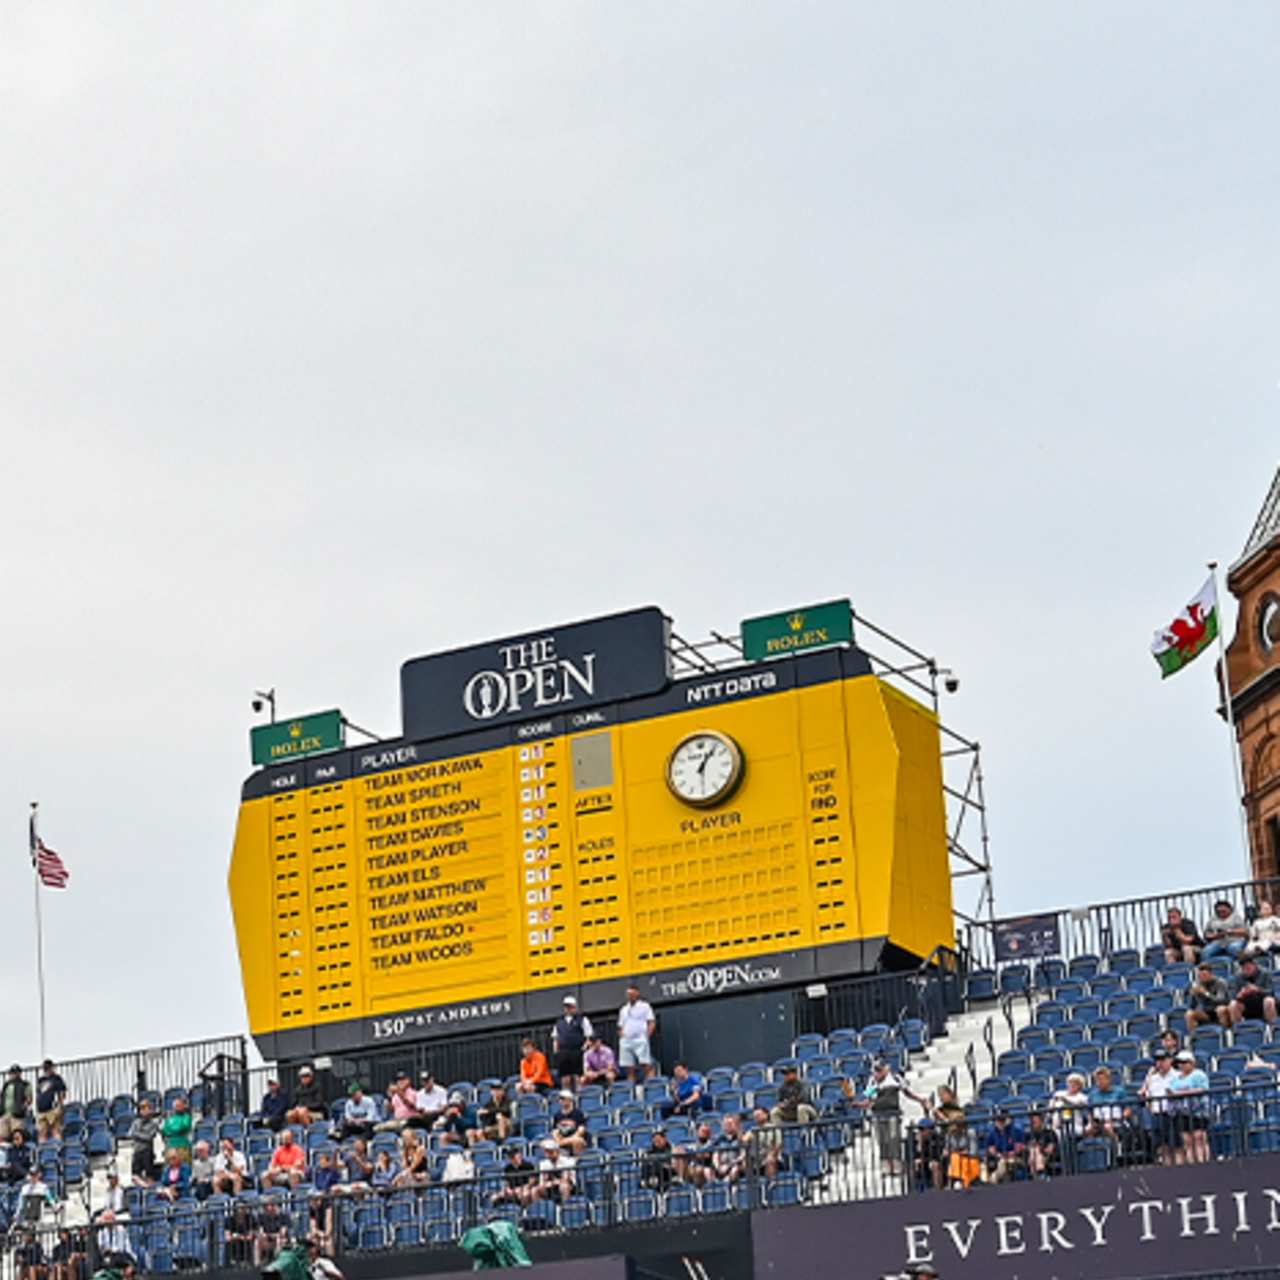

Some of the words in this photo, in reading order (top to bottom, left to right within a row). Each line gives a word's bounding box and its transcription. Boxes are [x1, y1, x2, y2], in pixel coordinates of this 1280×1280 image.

[499, 637, 557, 669] THE
[767, 628, 829, 652] ROLEX
[464, 653, 596, 719] OPEN
[270, 736, 322, 757] ROLEX
[361, 746, 418, 769] PLAYER
[365, 772, 404, 792] TEAM
[407, 758, 485, 784] MORIKAWA
[366, 792, 406, 811] TEAM
[409, 781, 462, 805] SPIETH
[575, 793, 613, 808] AFTER
[367, 812, 407, 831] TEAM
[410, 799, 482, 825] STENSON
[680, 812, 742, 834] PLAYER
[367, 832, 409, 851] TEAM
[411, 822, 465, 845] DAVIES
[367, 852, 410, 871] TEAM
[411, 841, 469, 864] PLAYER
[367, 872, 410, 891] TEAM
[412, 866, 441, 884] ELS
[369, 892, 410, 911] TEAM
[413, 878, 487, 904] MATTHEW
[370, 912, 411, 931] TEAM
[413, 900, 479, 924] WATSON
[371, 932, 413, 951] TEAM
[414, 922, 465, 945] FALDO
[371, 952, 413, 971] TEAM
[415, 941, 475, 964] WOODS
[416, 1012, 434, 1026] ST
[438, 1000, 512, 1023] ANDREWS
